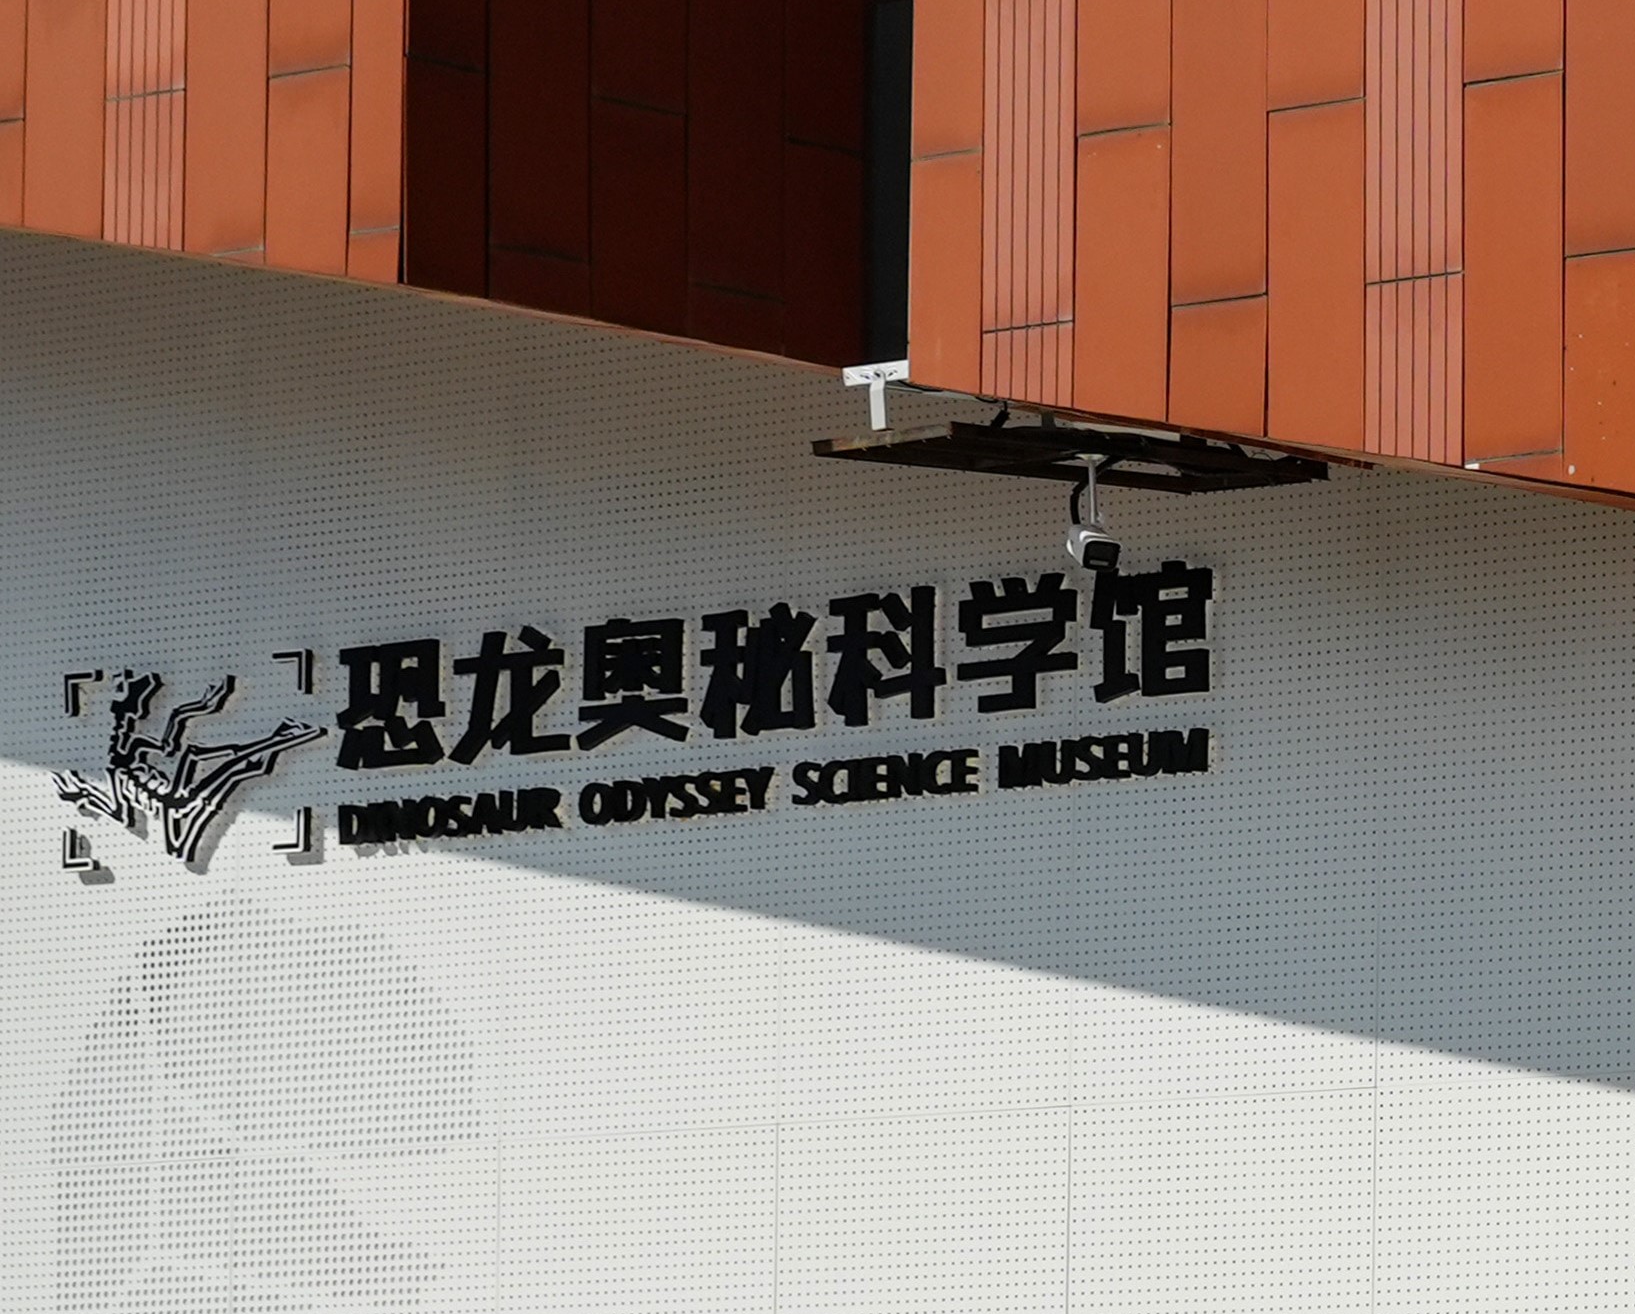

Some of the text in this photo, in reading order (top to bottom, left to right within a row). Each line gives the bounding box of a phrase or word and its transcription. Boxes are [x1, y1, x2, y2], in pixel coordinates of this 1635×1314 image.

[336, 560, 1213, 770] 恐龙奥秘科学馆
[338, 727, 1210, 845] DINOSAUR ODYSSEY SCIENCE MUSEUM
